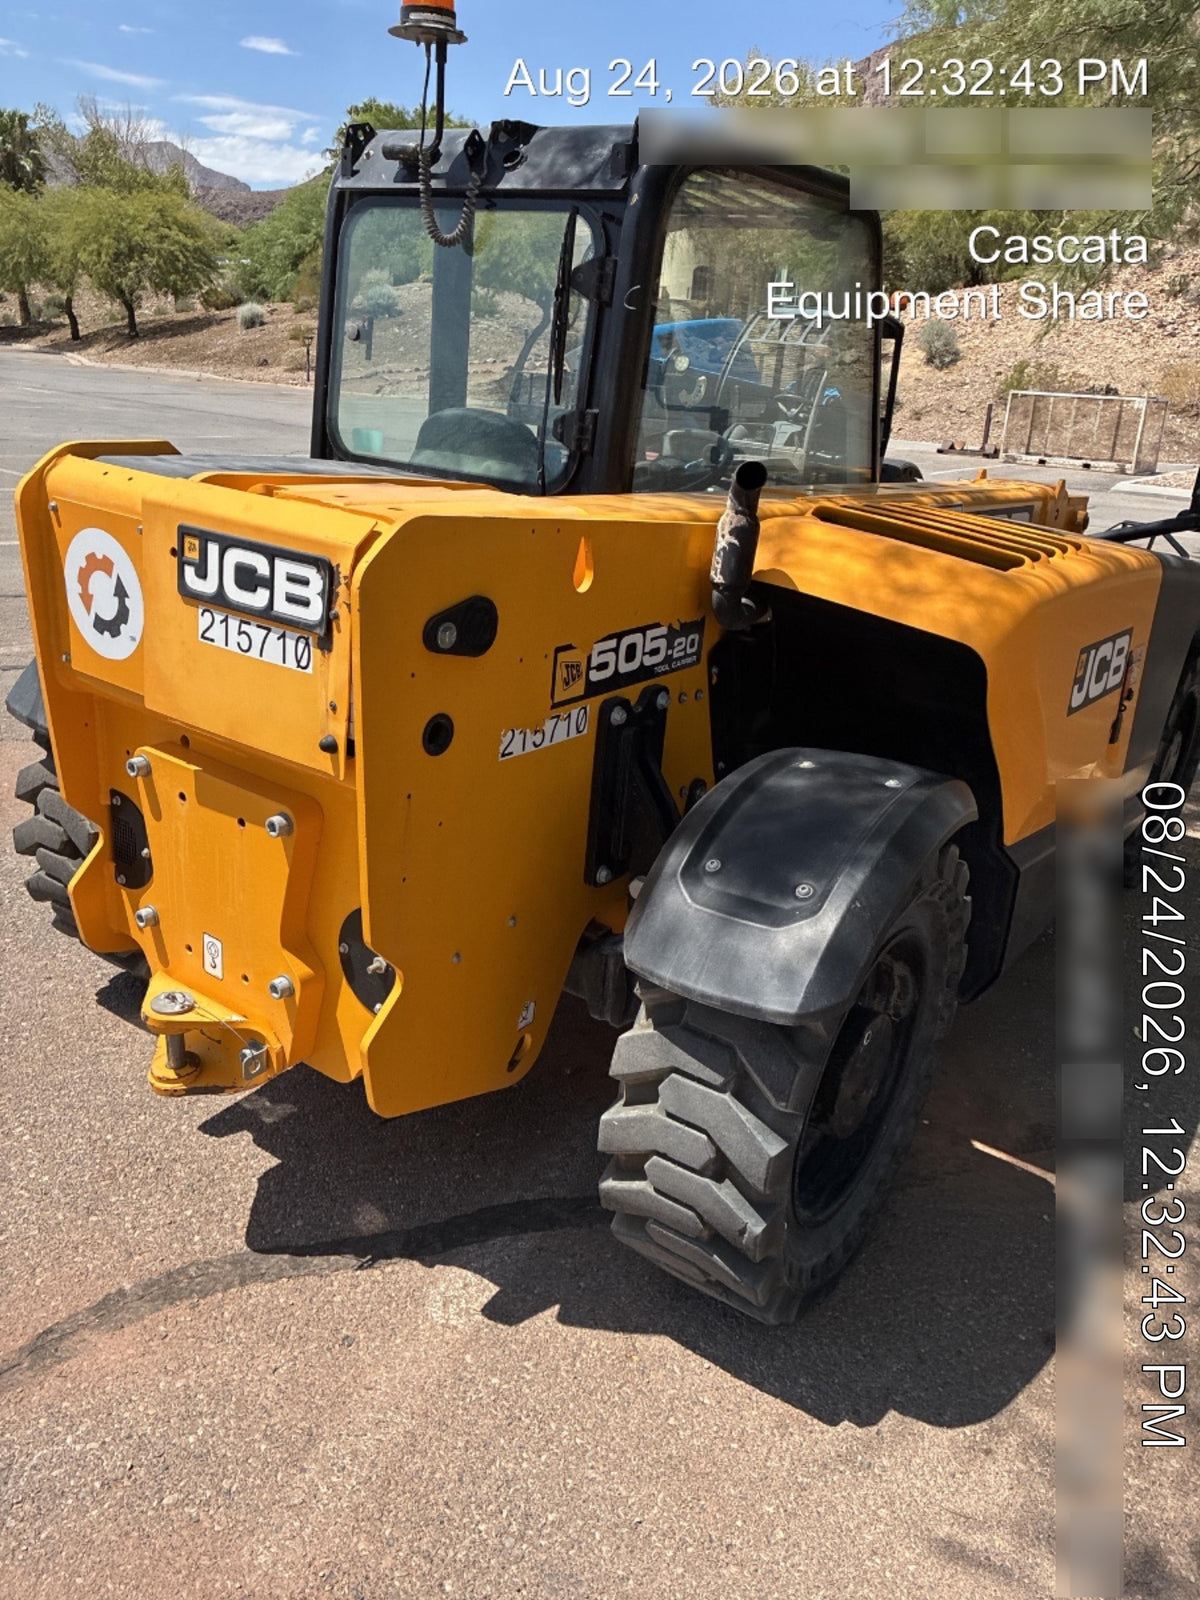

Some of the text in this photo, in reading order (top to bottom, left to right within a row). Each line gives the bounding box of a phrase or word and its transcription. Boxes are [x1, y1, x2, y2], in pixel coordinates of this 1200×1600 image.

[183, 540, 324, 622] JCB
[200, 608, 312, 671] 215710
[1071, 634, 1131, 708] JCB
[562, 662, 582, 688] JCB
